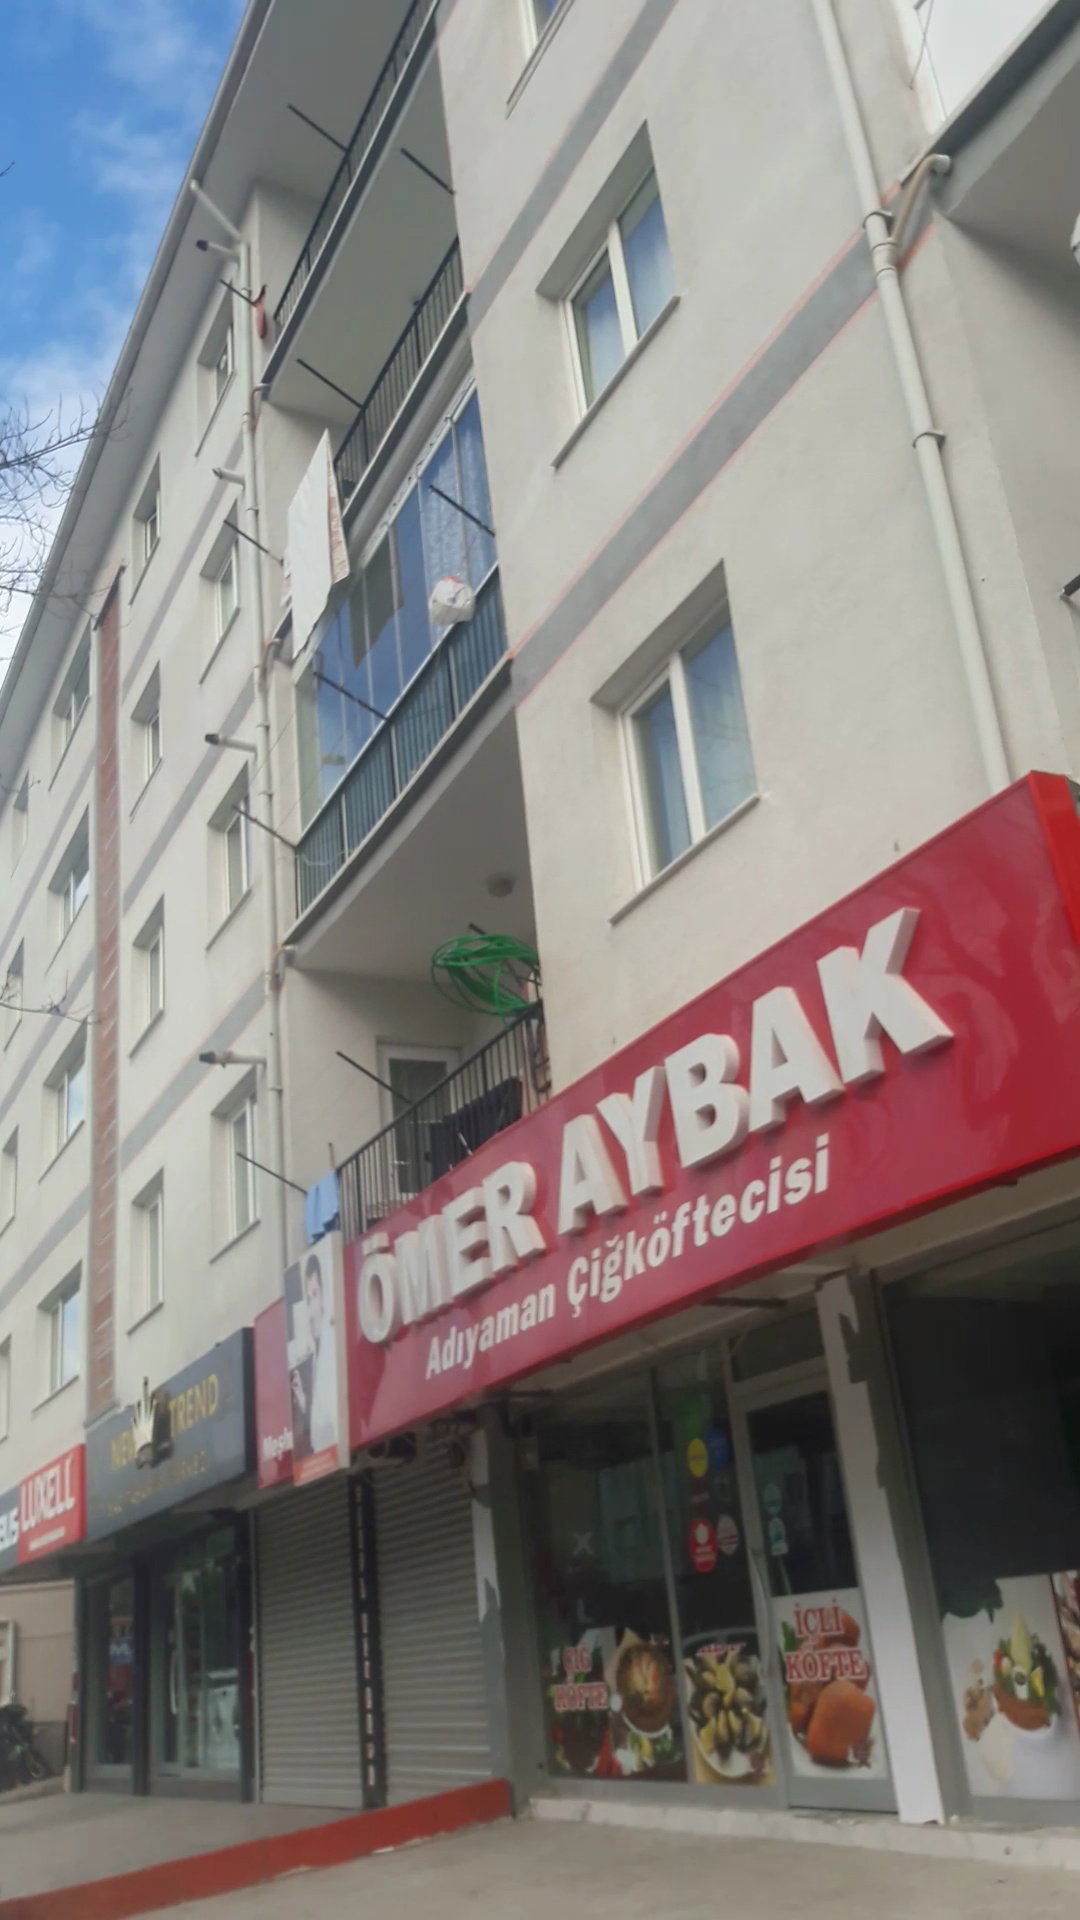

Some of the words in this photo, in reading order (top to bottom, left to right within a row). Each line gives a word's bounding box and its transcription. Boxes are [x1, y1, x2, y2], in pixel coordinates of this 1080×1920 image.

[357, 1161, 546, 1344] ÖMER
[557, 906, 954, 1237] AYBAK
[425, 1283, 556, 1380] Adıyaman
[568, 1134, 830, 1319] Çiğköftecisi
[168, 1373, 219, 1439] TREND
[21, 1453, 76, 1532] LUXELL
[785, 1645, 868, 1682] KÖFTE
